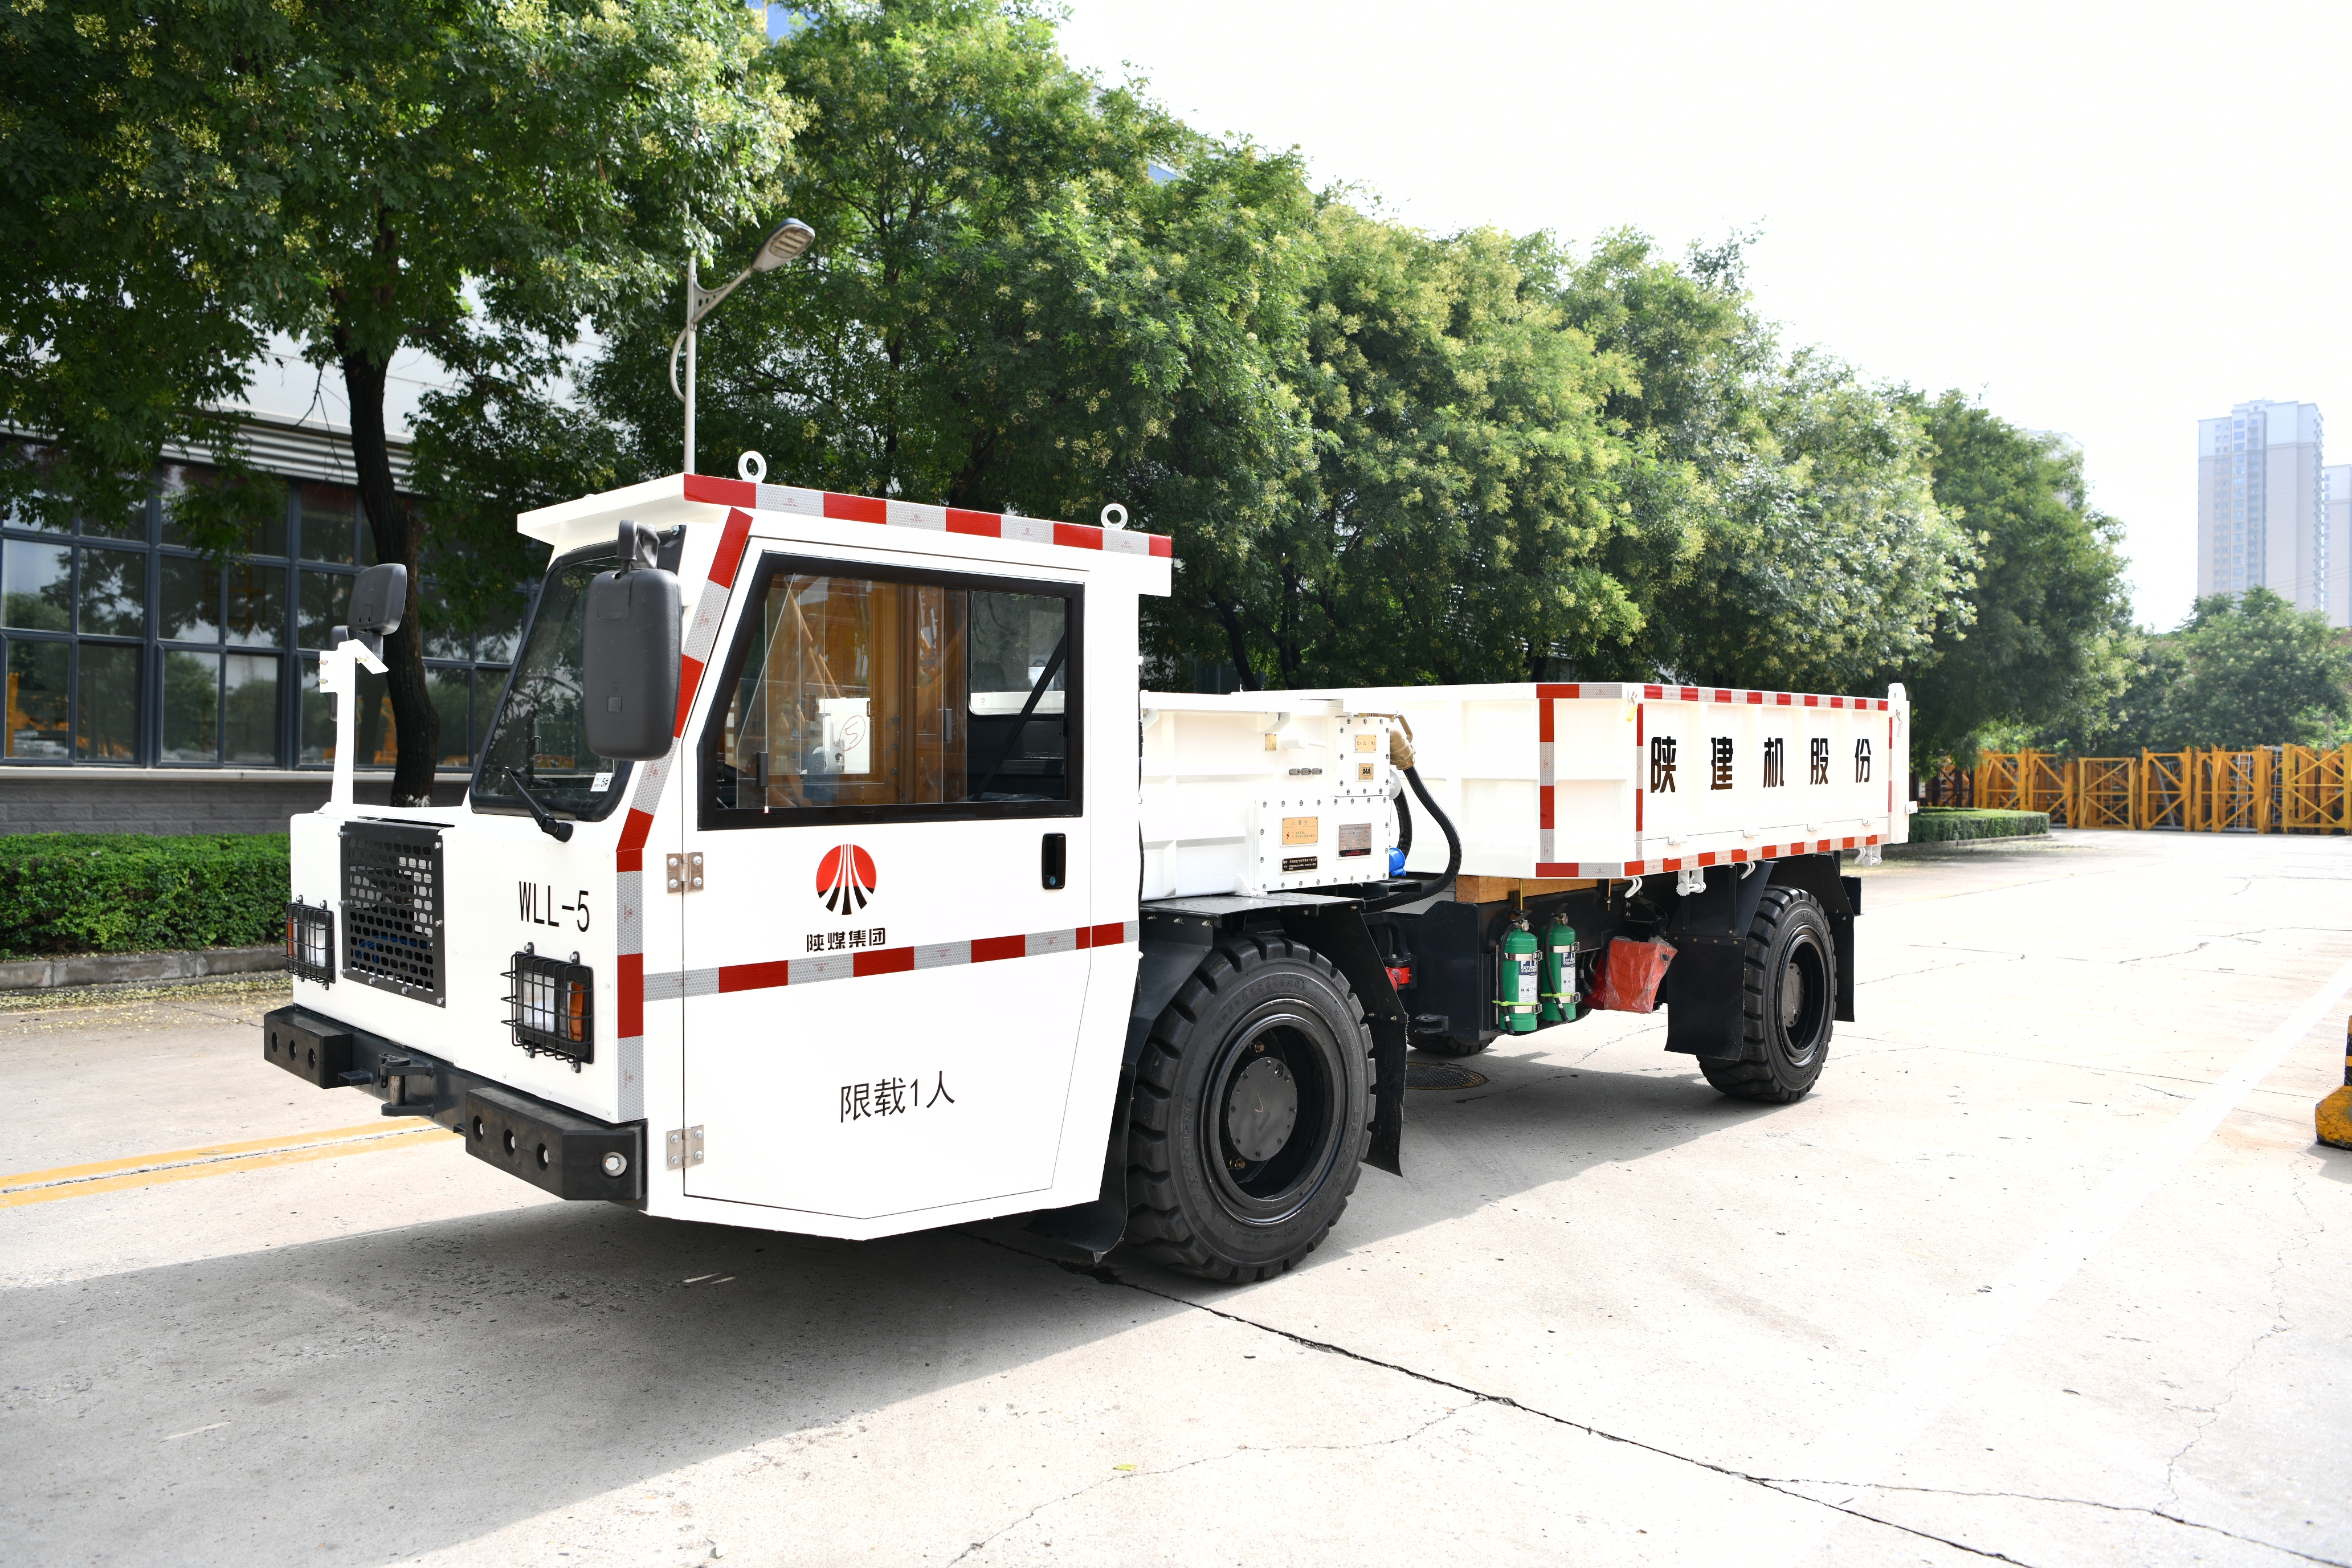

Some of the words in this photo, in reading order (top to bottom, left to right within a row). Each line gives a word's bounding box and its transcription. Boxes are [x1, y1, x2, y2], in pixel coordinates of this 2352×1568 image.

[844, 721, 859, 745] 5
[1650, 736, 1871, 793] 陕建机股份
[518, 881, 590, 933] WLL-5
[840, 1071, 955, 1123] 限载1人
